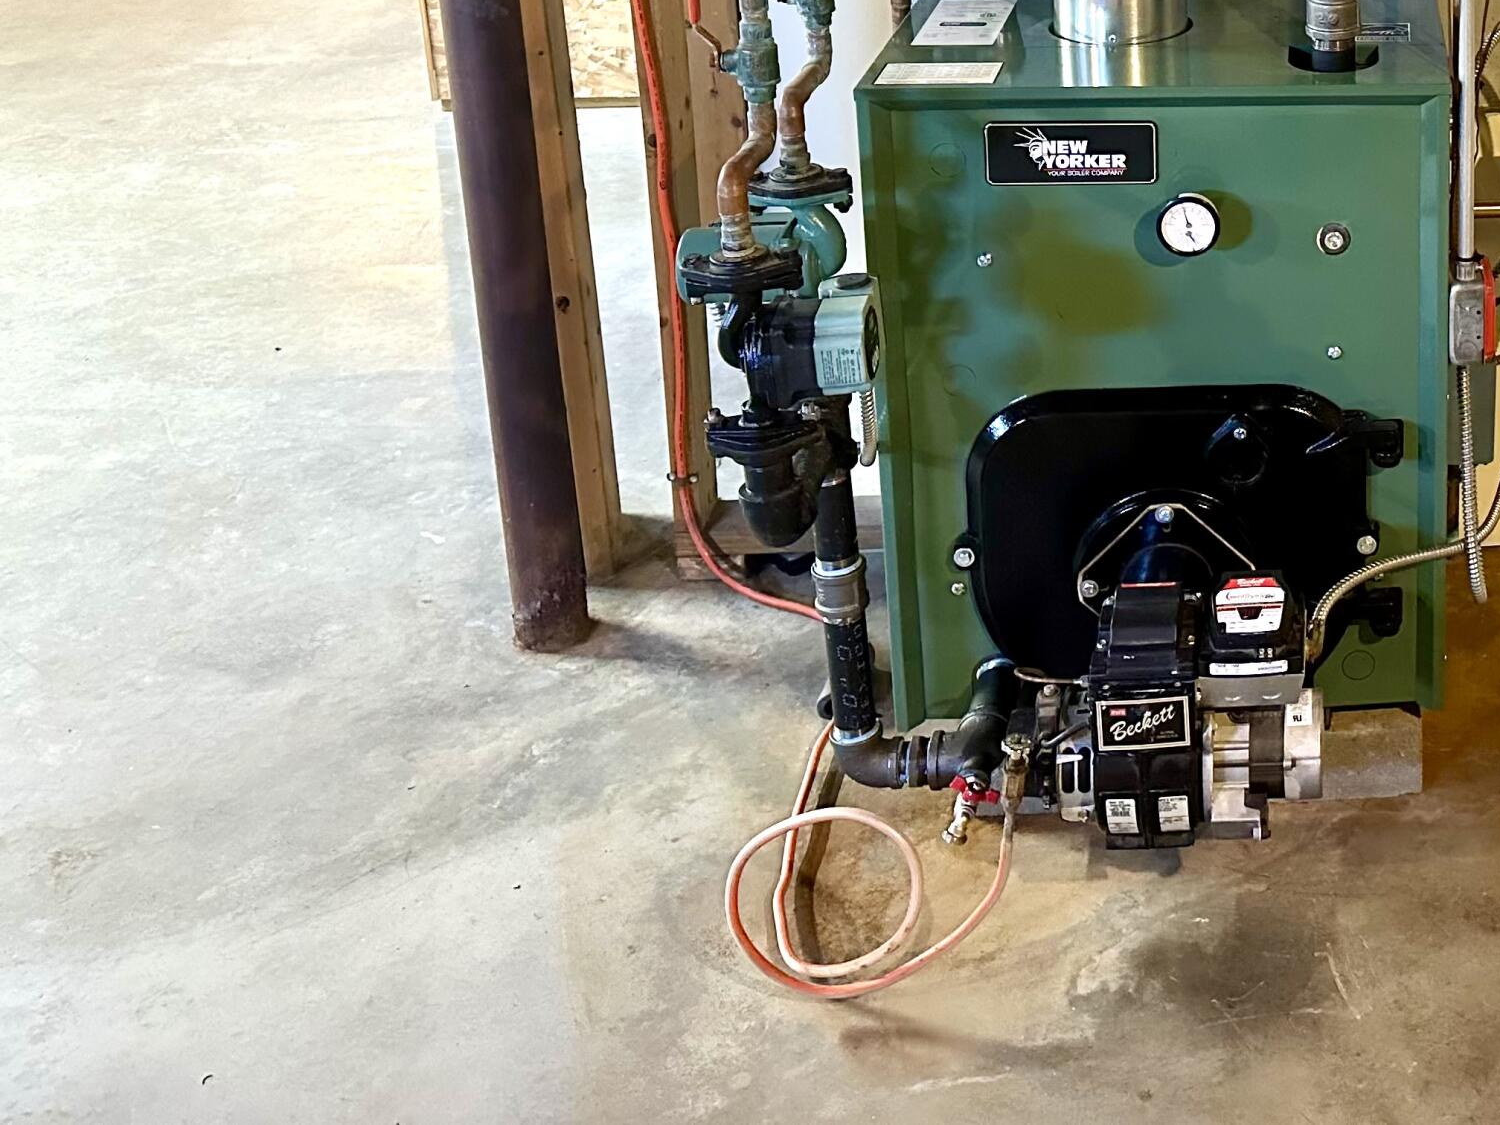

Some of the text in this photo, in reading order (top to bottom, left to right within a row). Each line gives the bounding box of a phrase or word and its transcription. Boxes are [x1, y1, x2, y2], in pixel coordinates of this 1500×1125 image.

[1043, 139, 1089, 155] NEW
[1044, 154, 1127, 169] YORKER
[1109, 703, 1176, 742] Beckett
